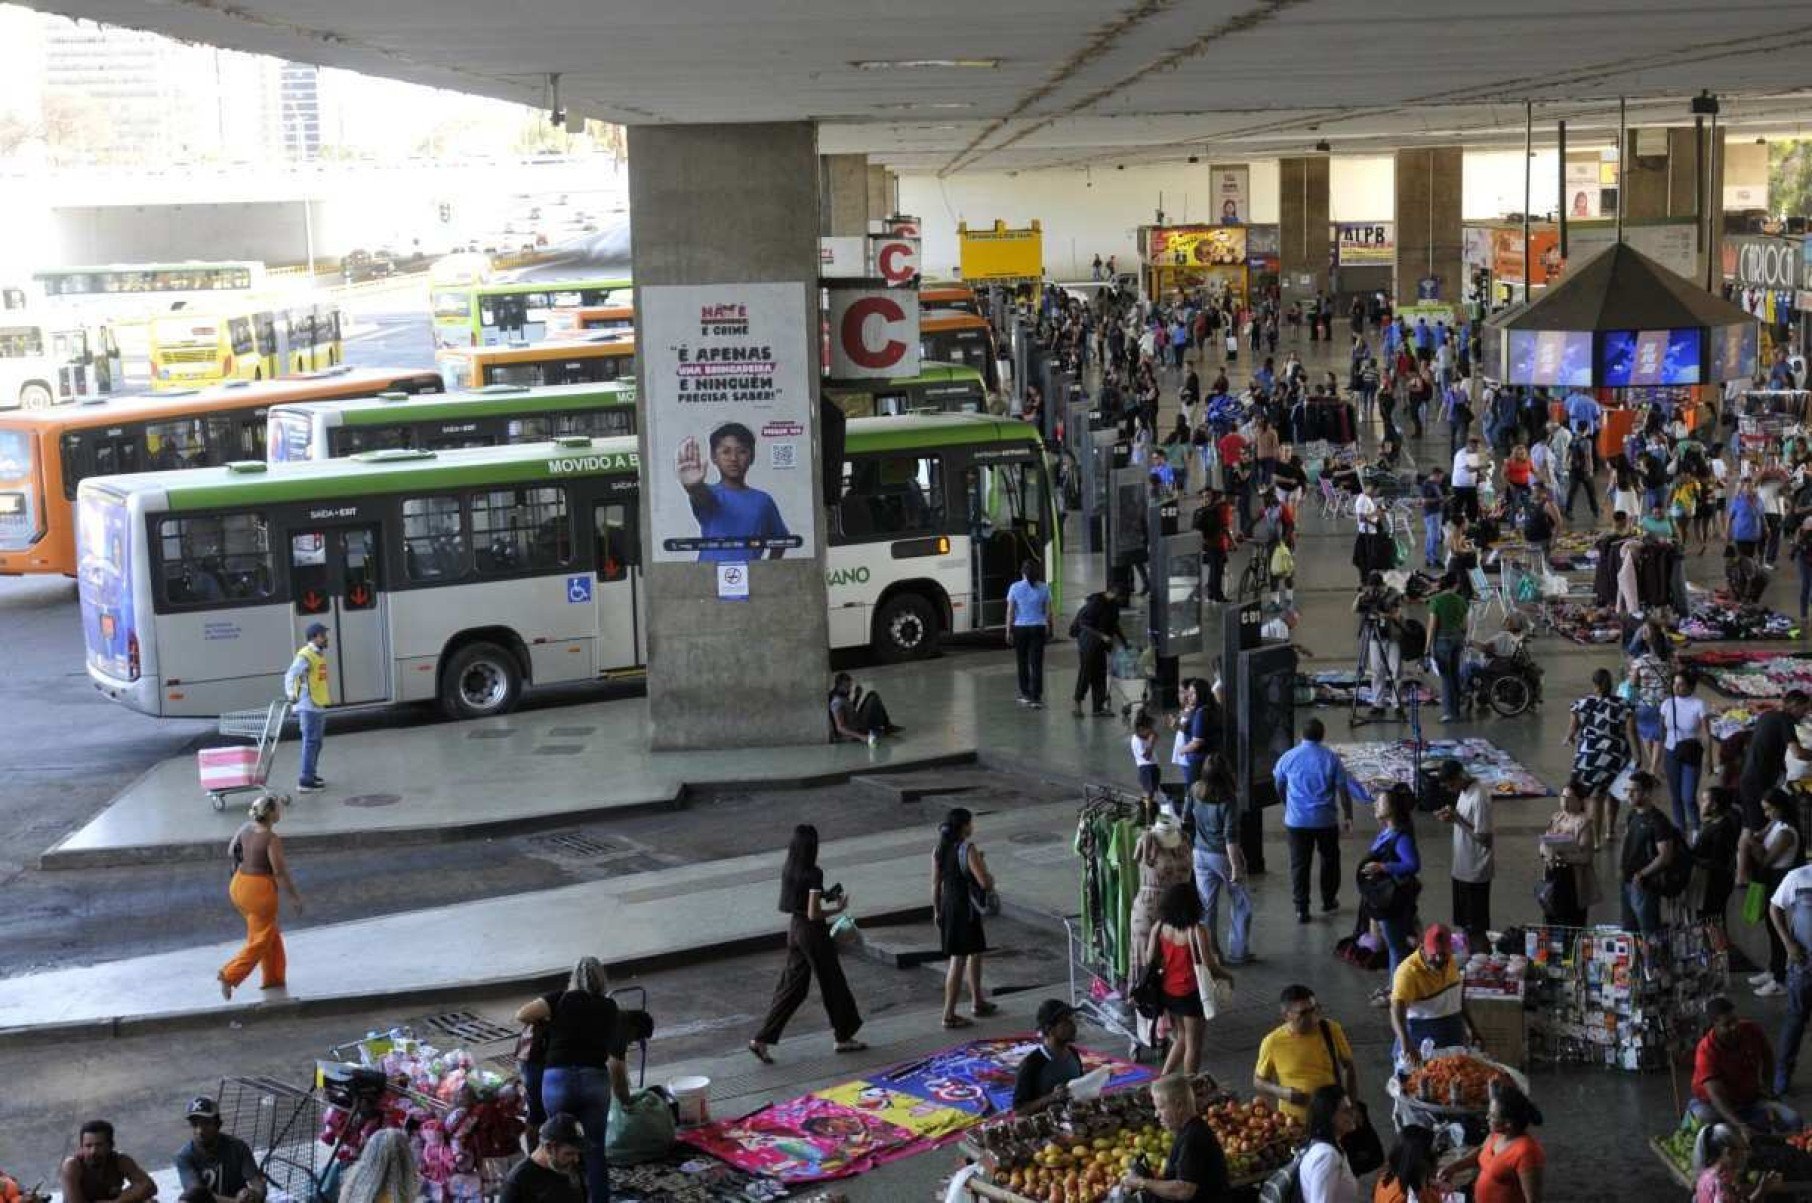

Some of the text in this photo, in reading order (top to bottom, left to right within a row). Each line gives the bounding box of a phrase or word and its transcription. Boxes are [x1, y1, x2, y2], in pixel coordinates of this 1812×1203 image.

[879, 243, 914, 281] C
[841, 296, 907, 369] C
[696, 346, 772, 362] APENAS
[680, 378, 688, 391] E
[677, 391, 728, 403] PRECISA
[548, 456, 612, 473] MOVIDO
[615, 455, 626, 467] A
